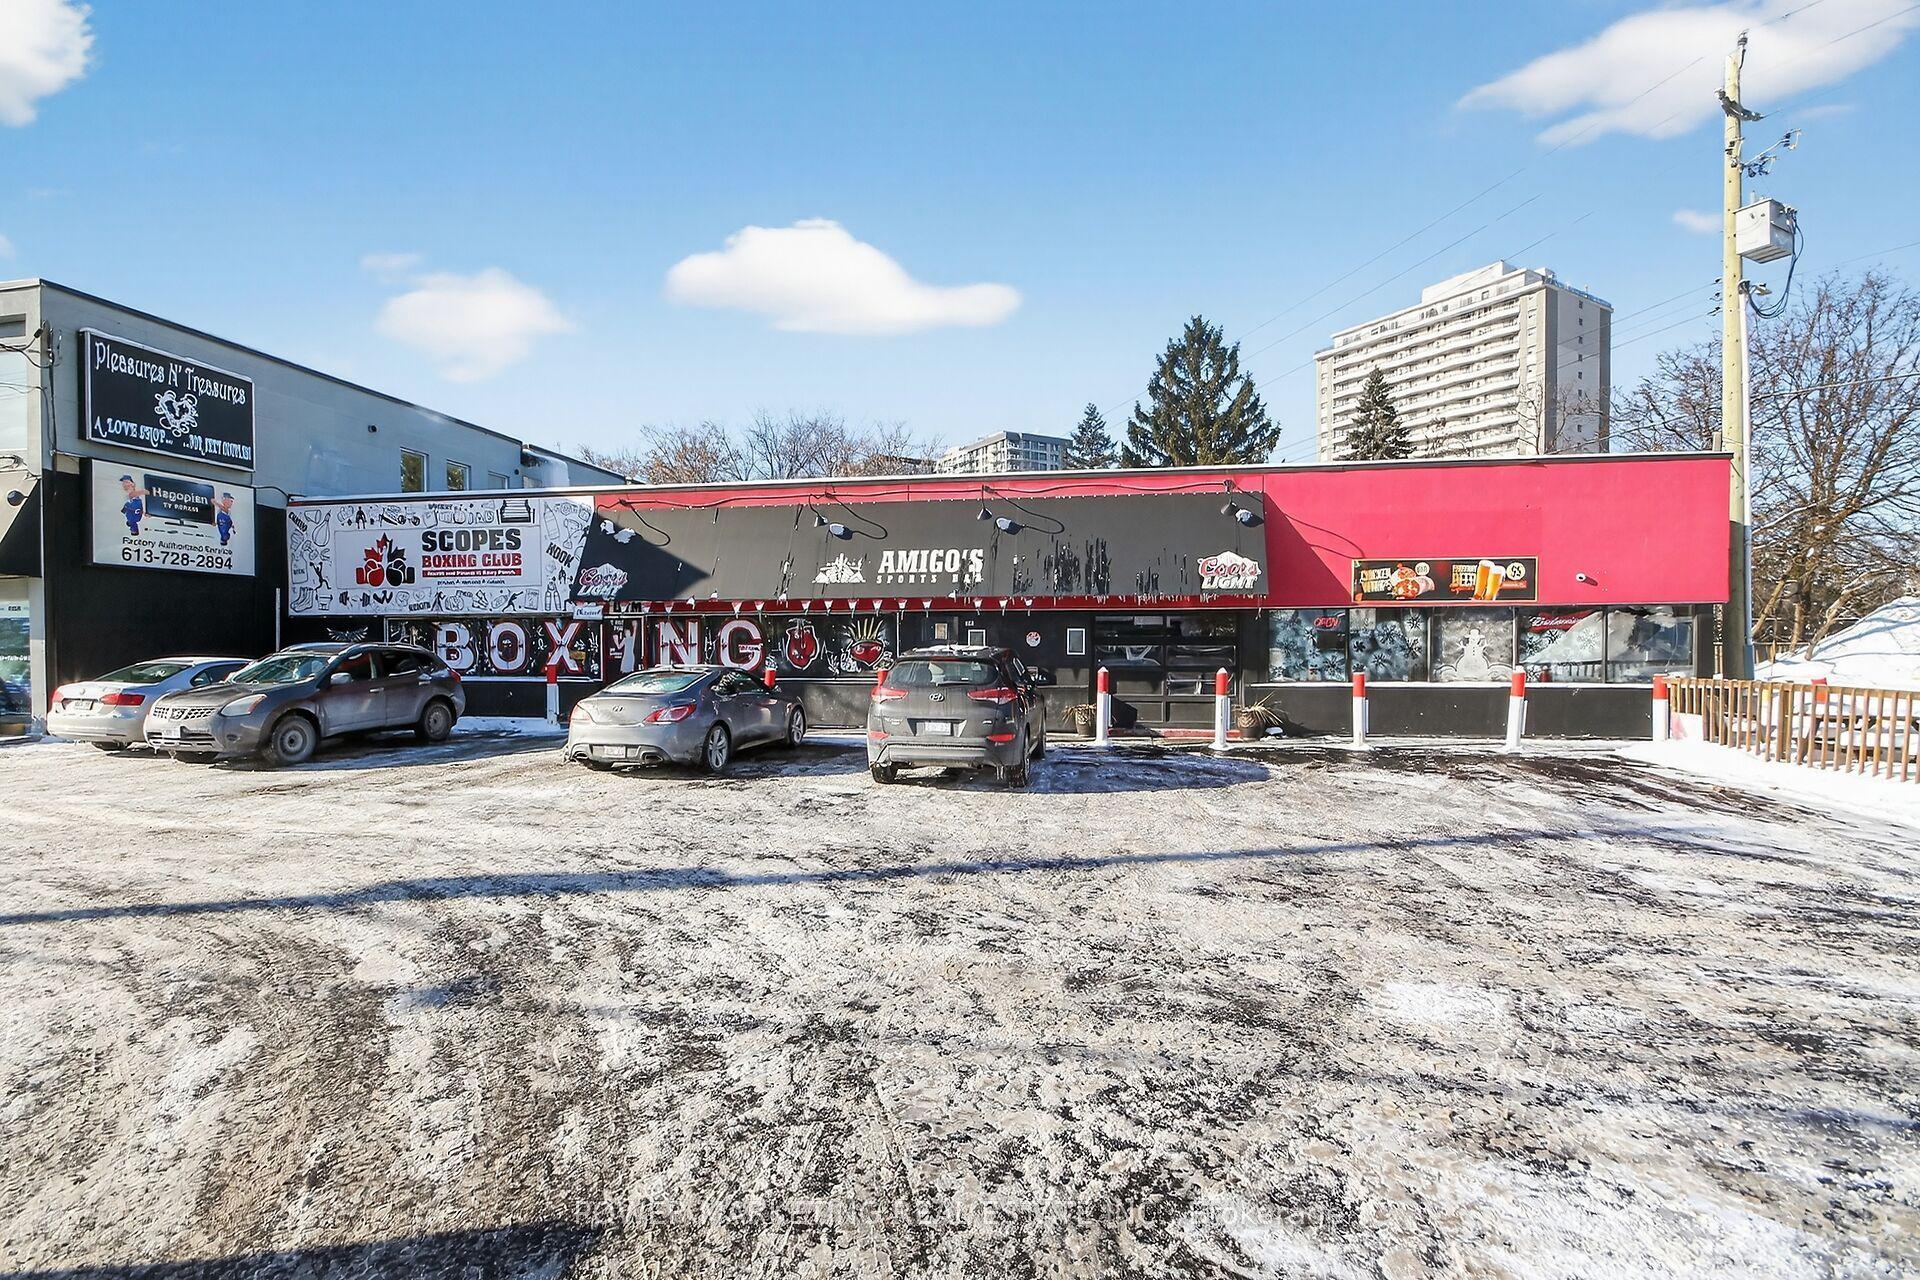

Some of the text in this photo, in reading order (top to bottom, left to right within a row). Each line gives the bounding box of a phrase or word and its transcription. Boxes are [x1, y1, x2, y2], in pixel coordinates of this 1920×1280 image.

[95, 342, 246, 405] Pleasures N' Treasures
[94, 416, 107, 438] A
[107, 418, 137, 438] LOVE
[152, 487, 208, 504] Hagopian
[122, 536, 156, 548] Factory
[421, 529, 521, 552] SCOPES
[122, 547, 233, 570] 613-728-2894
[421, 552, 522, 568] BOXING CLUB
[878, 548, 984, 573] AMIGO'S
[1198, 556, 1261, 577] Coors
[876, 574, 937, 584] SPORTS
[1201, 575, 1258, 589] LIGHT
[436, 618, 763, 673] BOXNG
